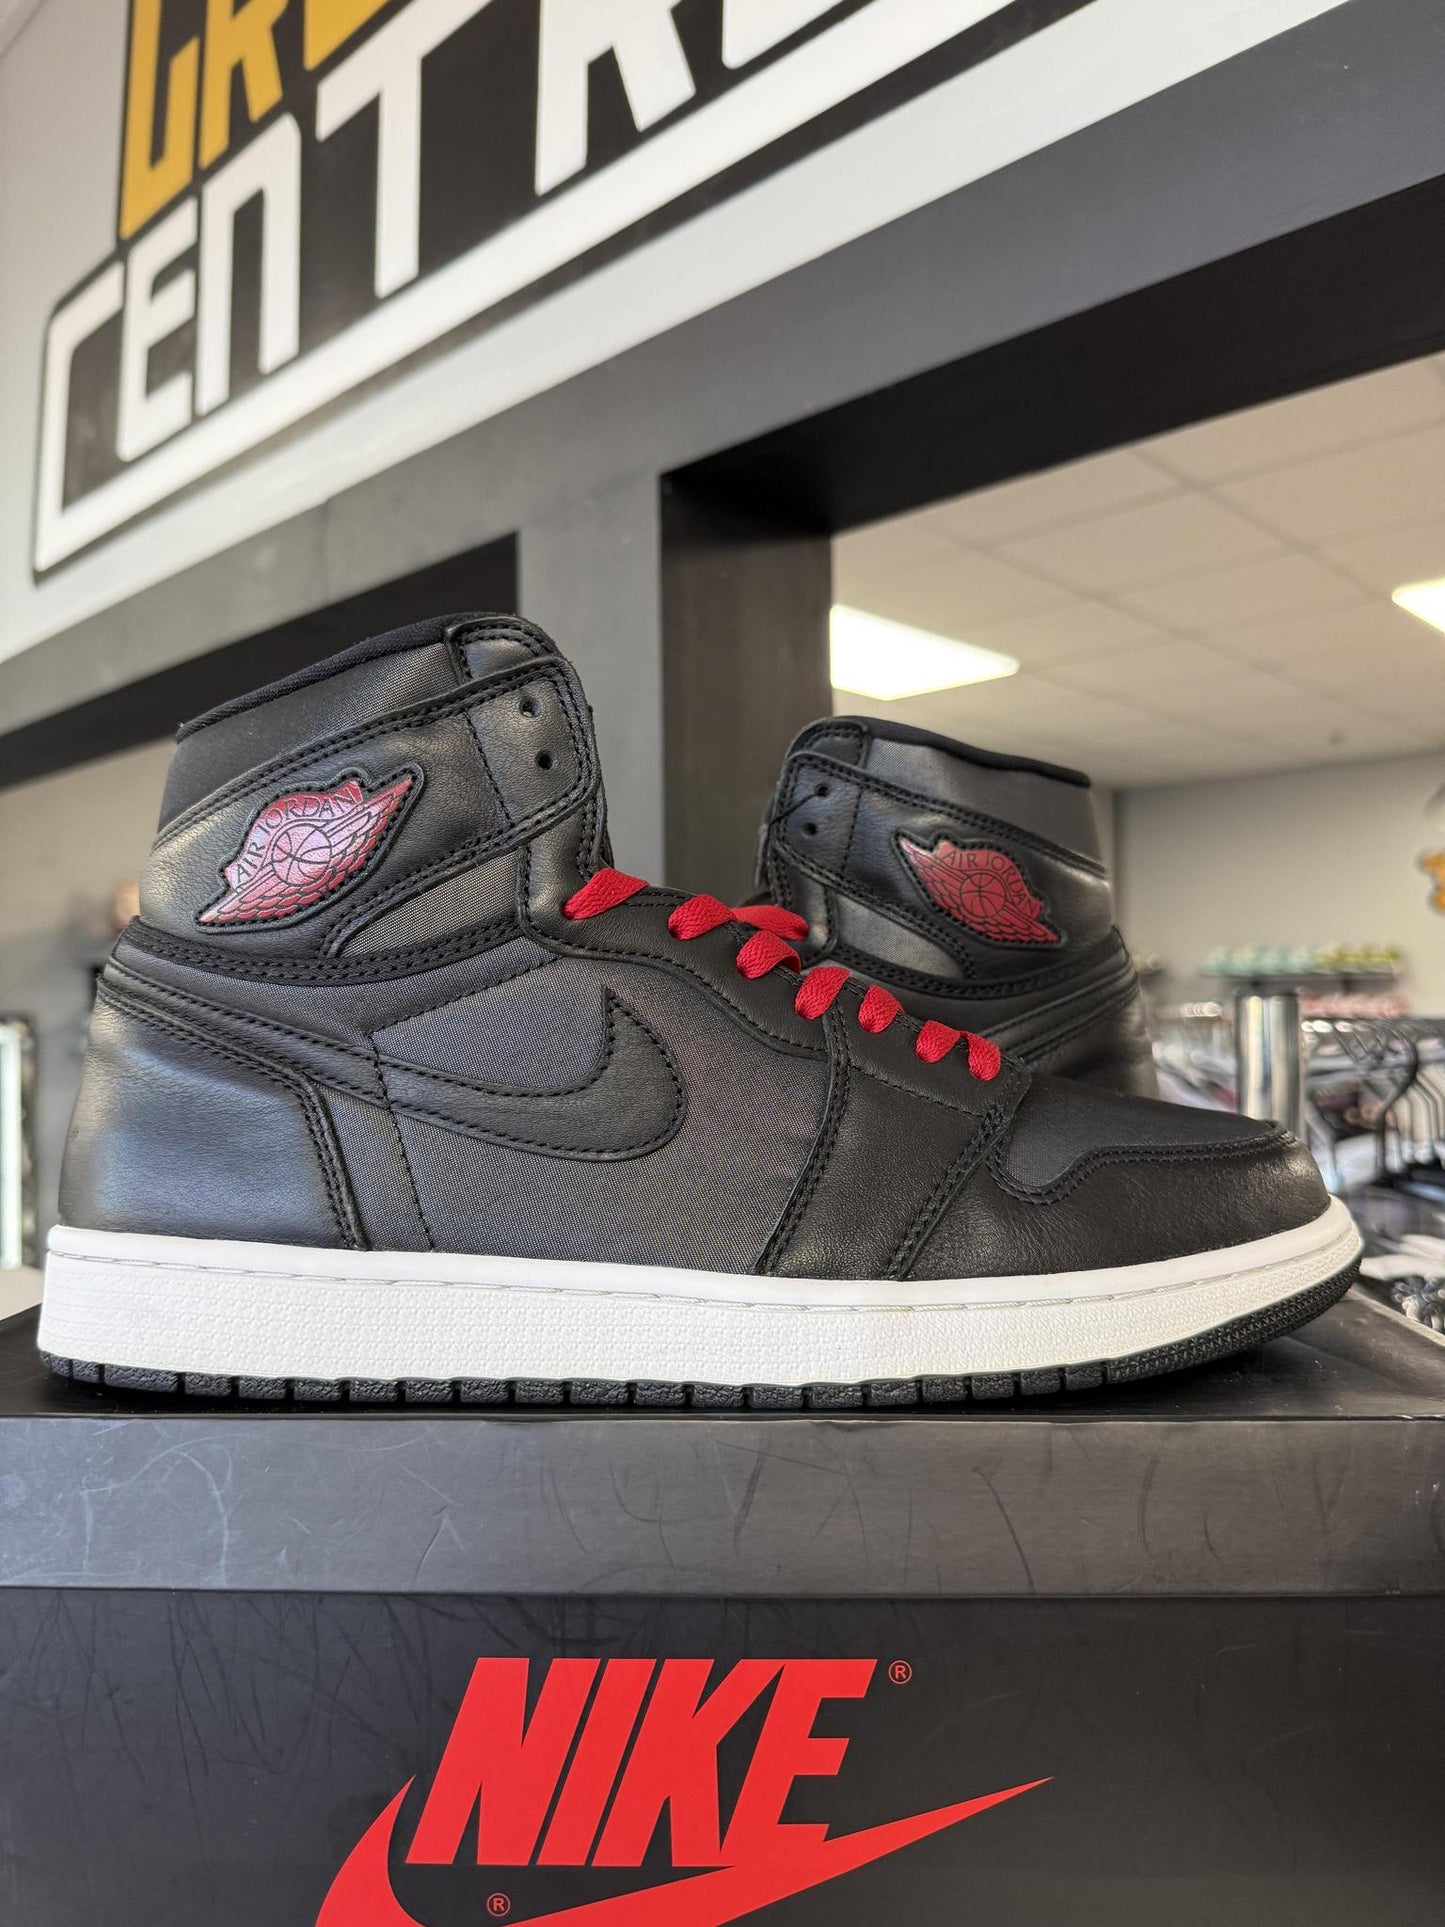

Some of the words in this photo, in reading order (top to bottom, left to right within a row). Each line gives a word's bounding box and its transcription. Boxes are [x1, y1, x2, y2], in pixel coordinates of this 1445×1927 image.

[35, 0, 850, 572] CENTR
[236, 841, 266, 883] AIR
[256, 788, 359, 836] JORDAN
[942, 851, 979, 868] AIR
[985, 852, 1037, 915] JORDAN
[405, 1657, 877, 1866] NIKE
